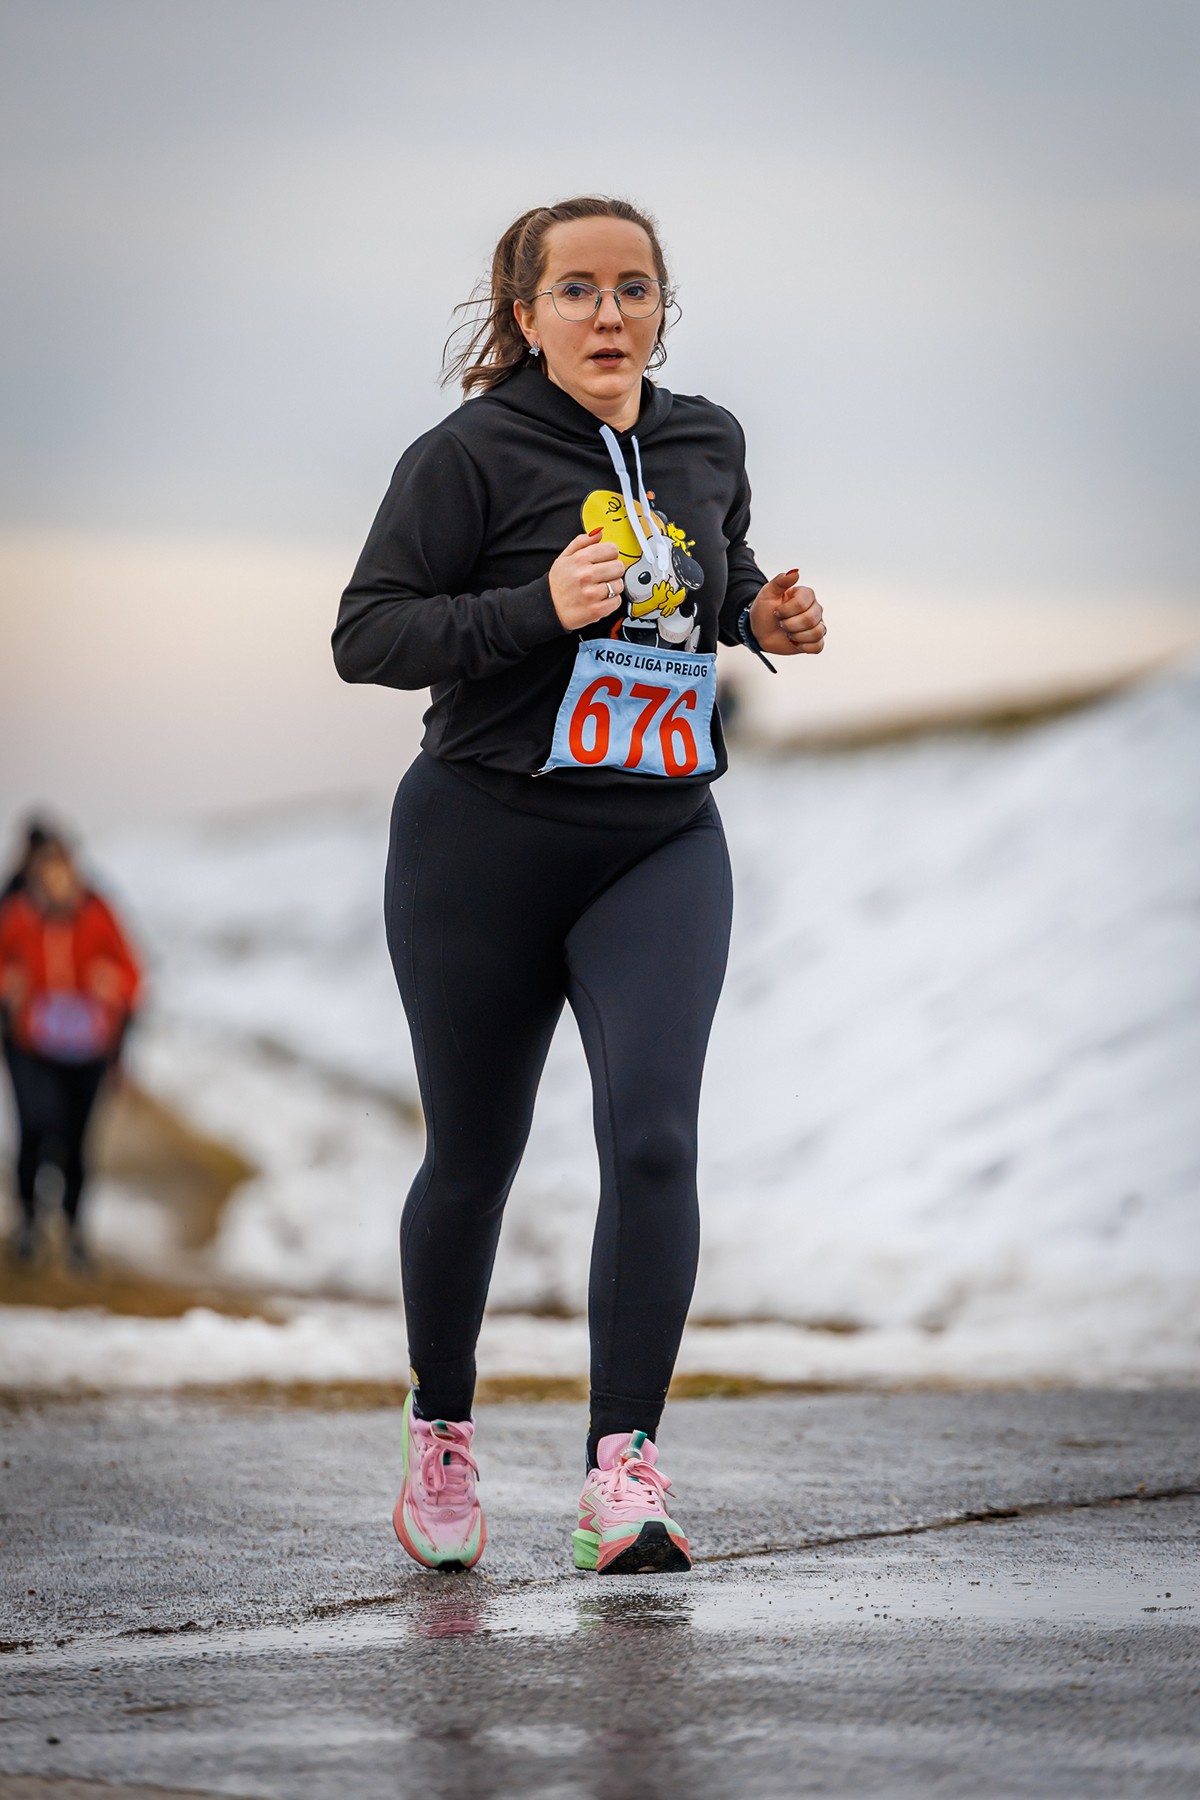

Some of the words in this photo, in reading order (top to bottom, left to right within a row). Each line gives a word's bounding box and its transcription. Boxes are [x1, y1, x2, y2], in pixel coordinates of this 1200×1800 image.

[595, 650, 632, 667] KROS
[634, 656, 662, 672] LIGA
[665, 661, 708, 677] PRELOG
[568, 675, 699, 778] 676
